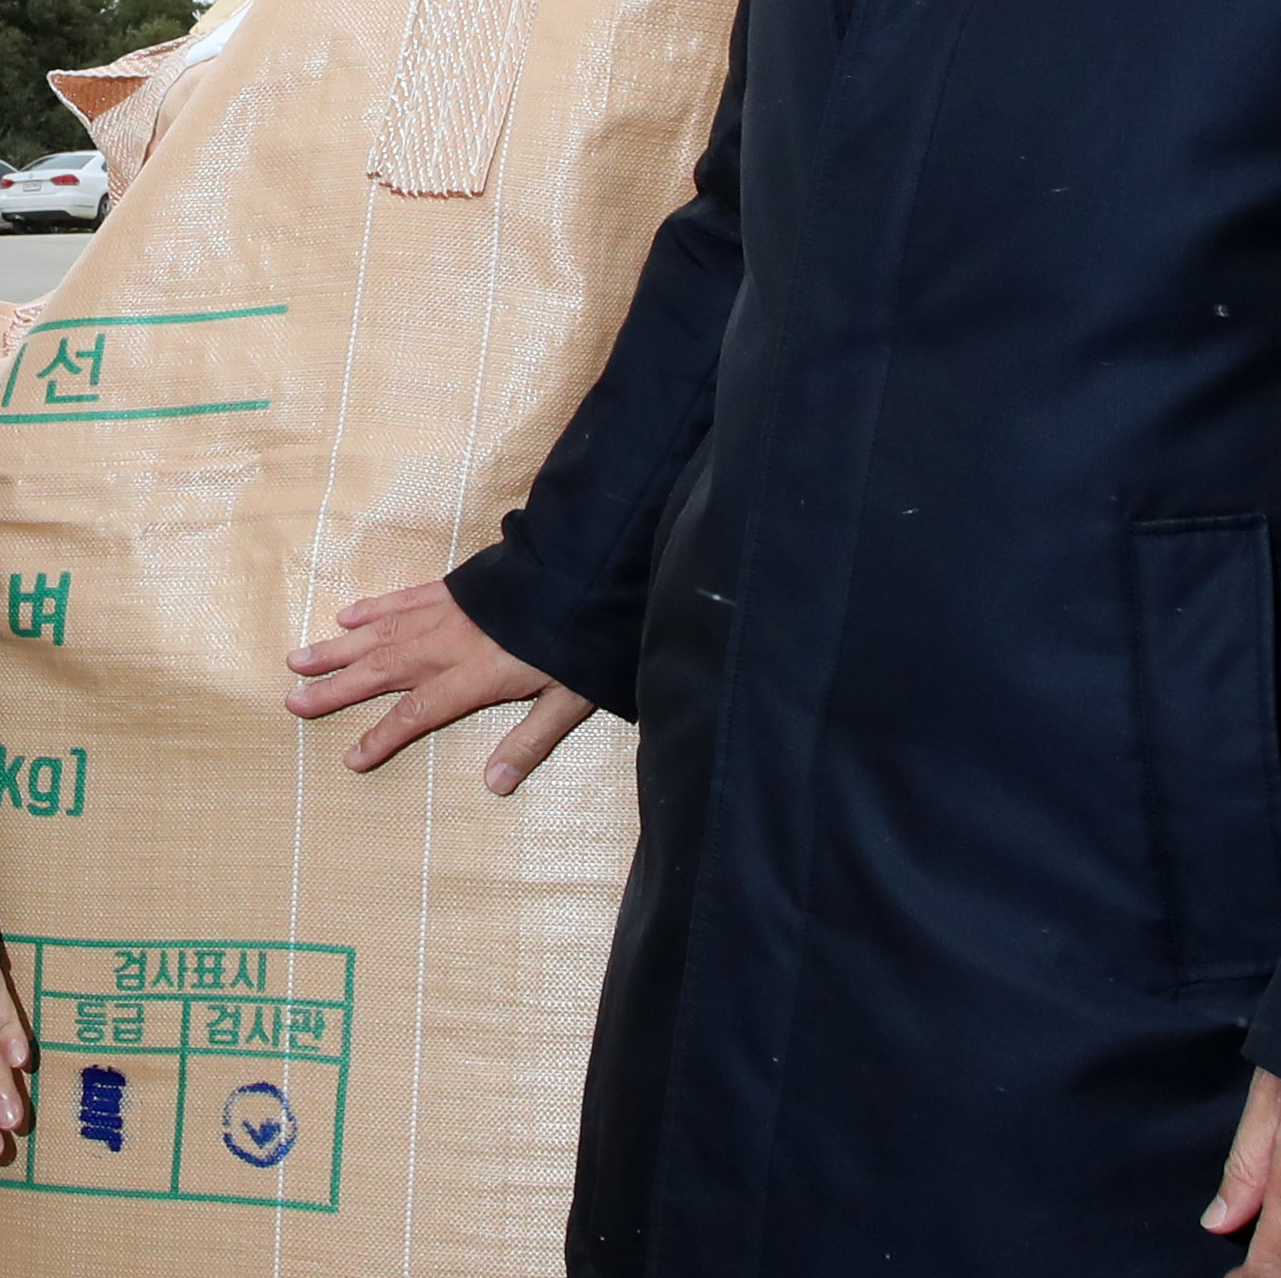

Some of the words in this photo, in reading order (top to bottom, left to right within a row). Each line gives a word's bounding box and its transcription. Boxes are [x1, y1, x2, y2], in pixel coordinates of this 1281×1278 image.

[112, 949, 268, 993] 검사표시
[74, 1001, 145, 1044] 등급
[205, 1003, 327, 1053] 검사관
